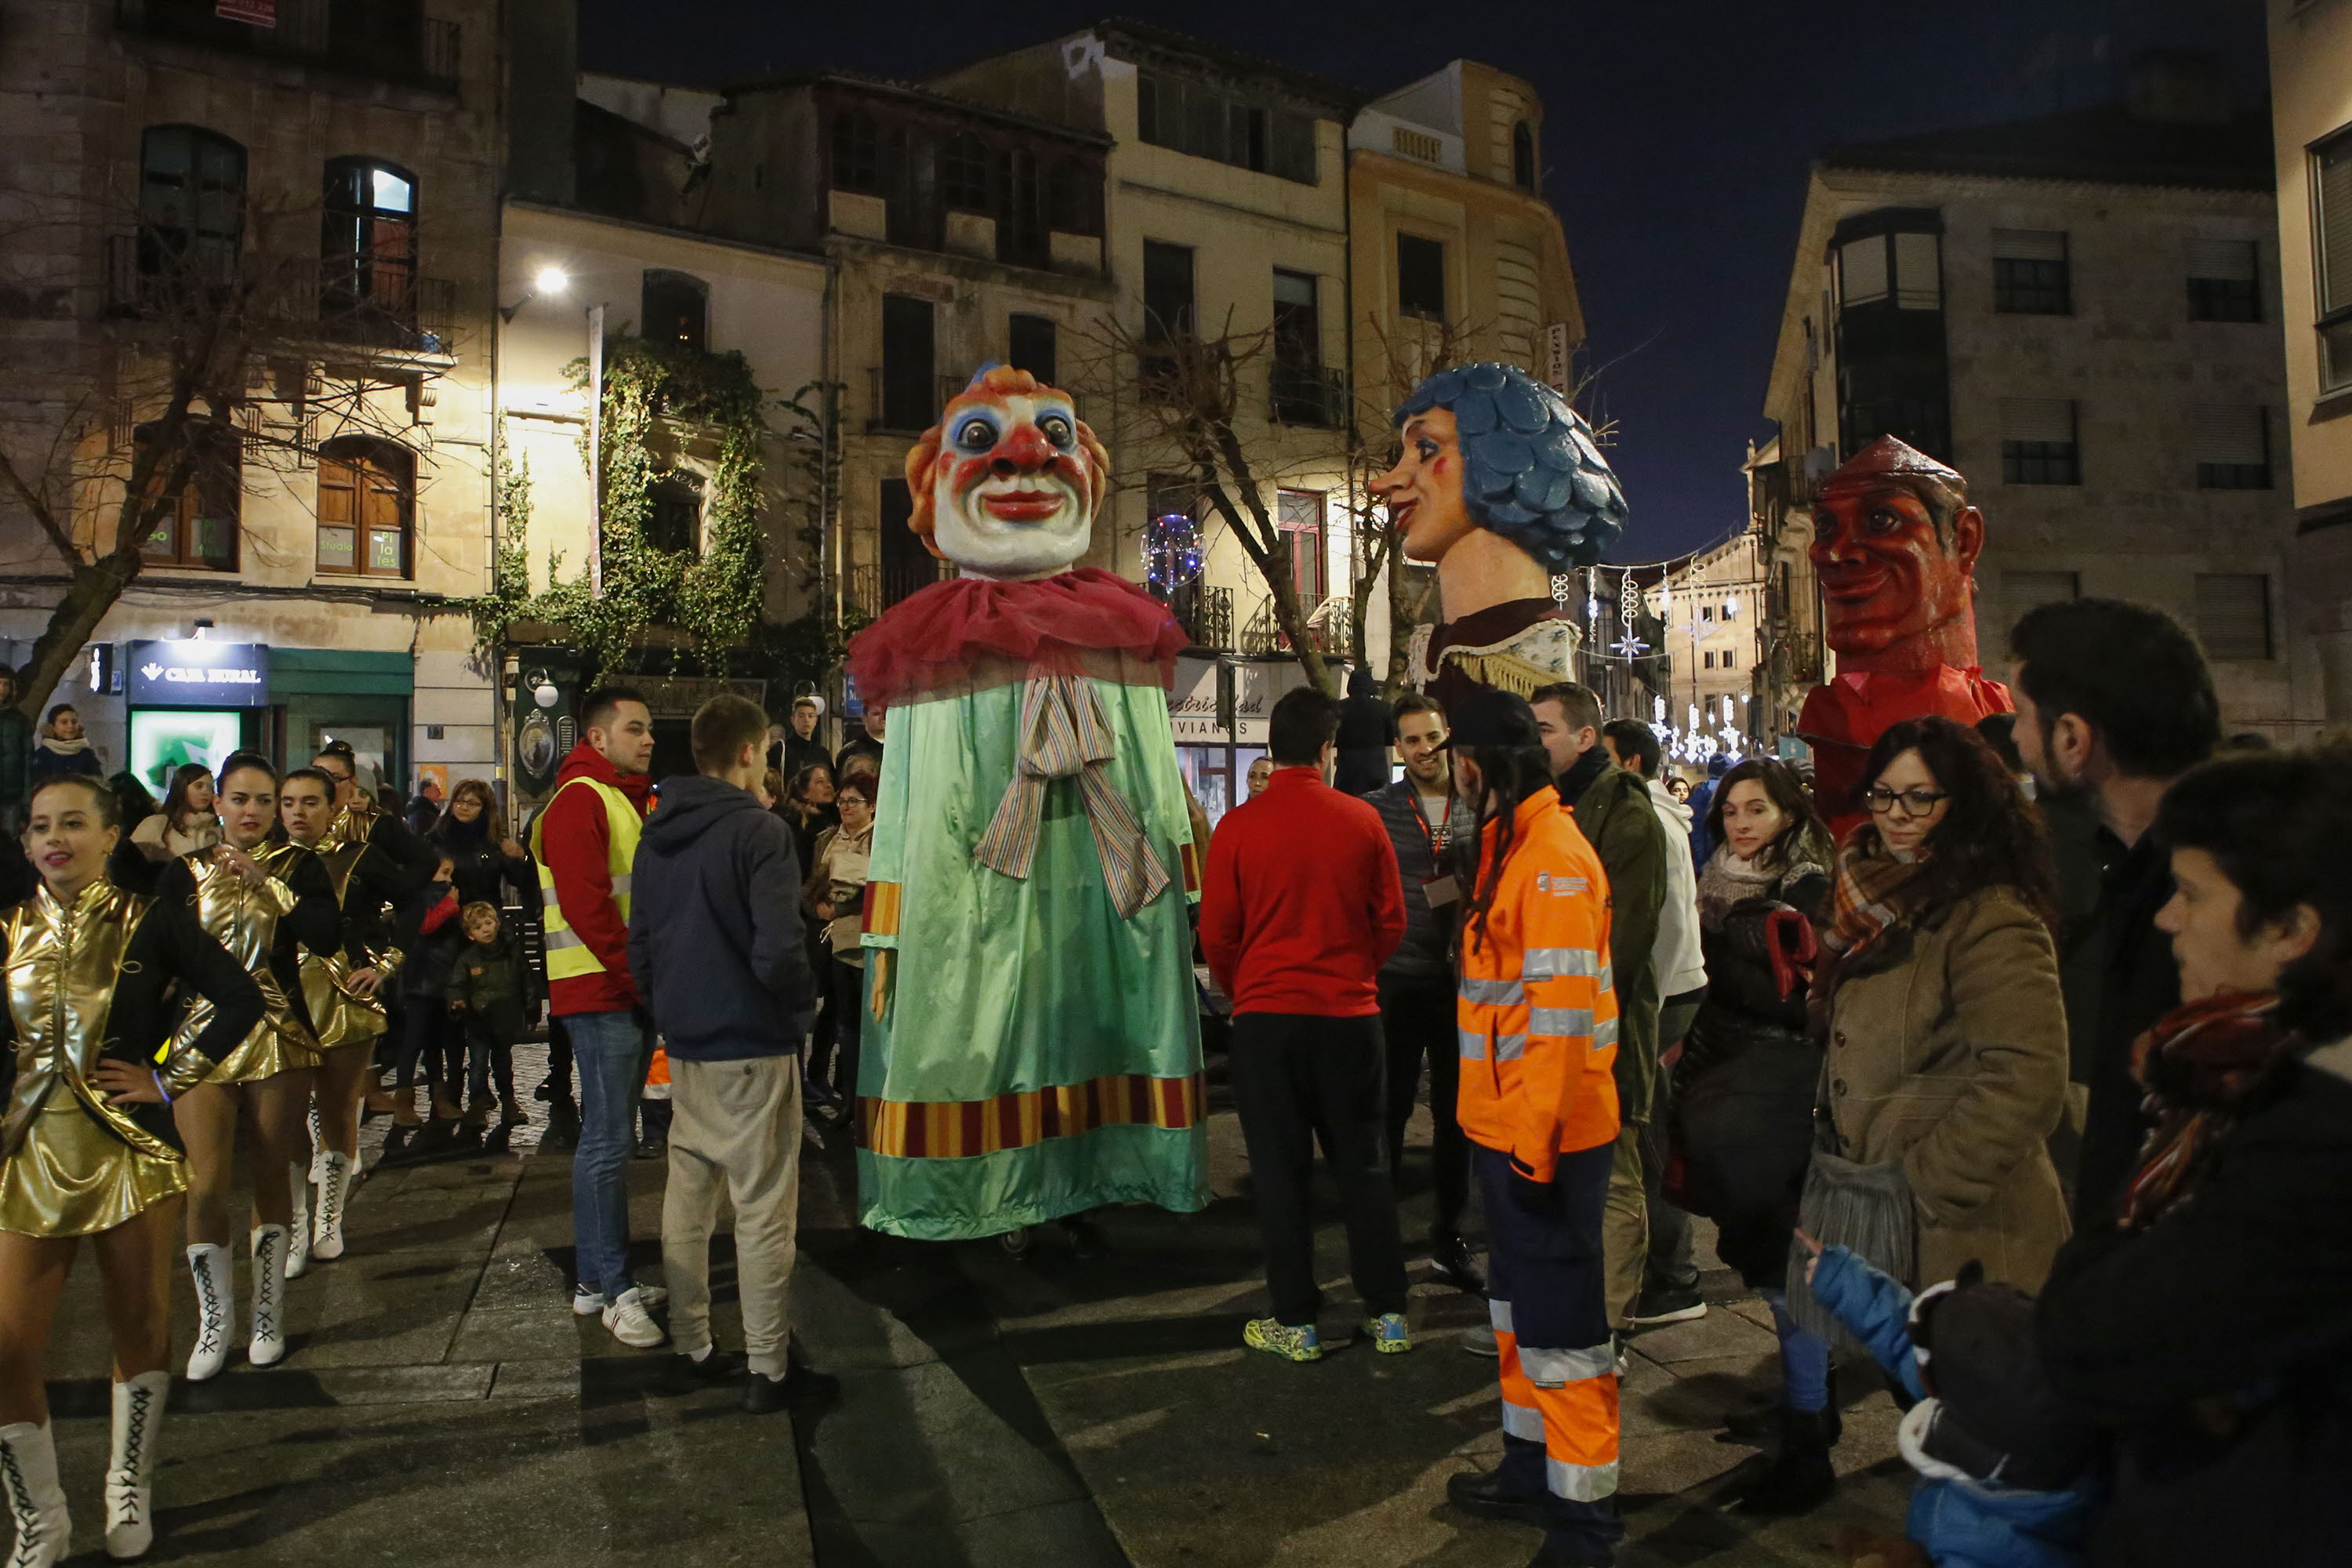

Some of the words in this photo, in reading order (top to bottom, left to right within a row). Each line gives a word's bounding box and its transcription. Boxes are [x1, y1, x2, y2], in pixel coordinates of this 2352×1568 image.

[381, 531, 393, 543] Pi
[320, 539, 354, 552] Studio
[376, 557, 396, 567] tes
[207, 668, 261, 684] RURAL
